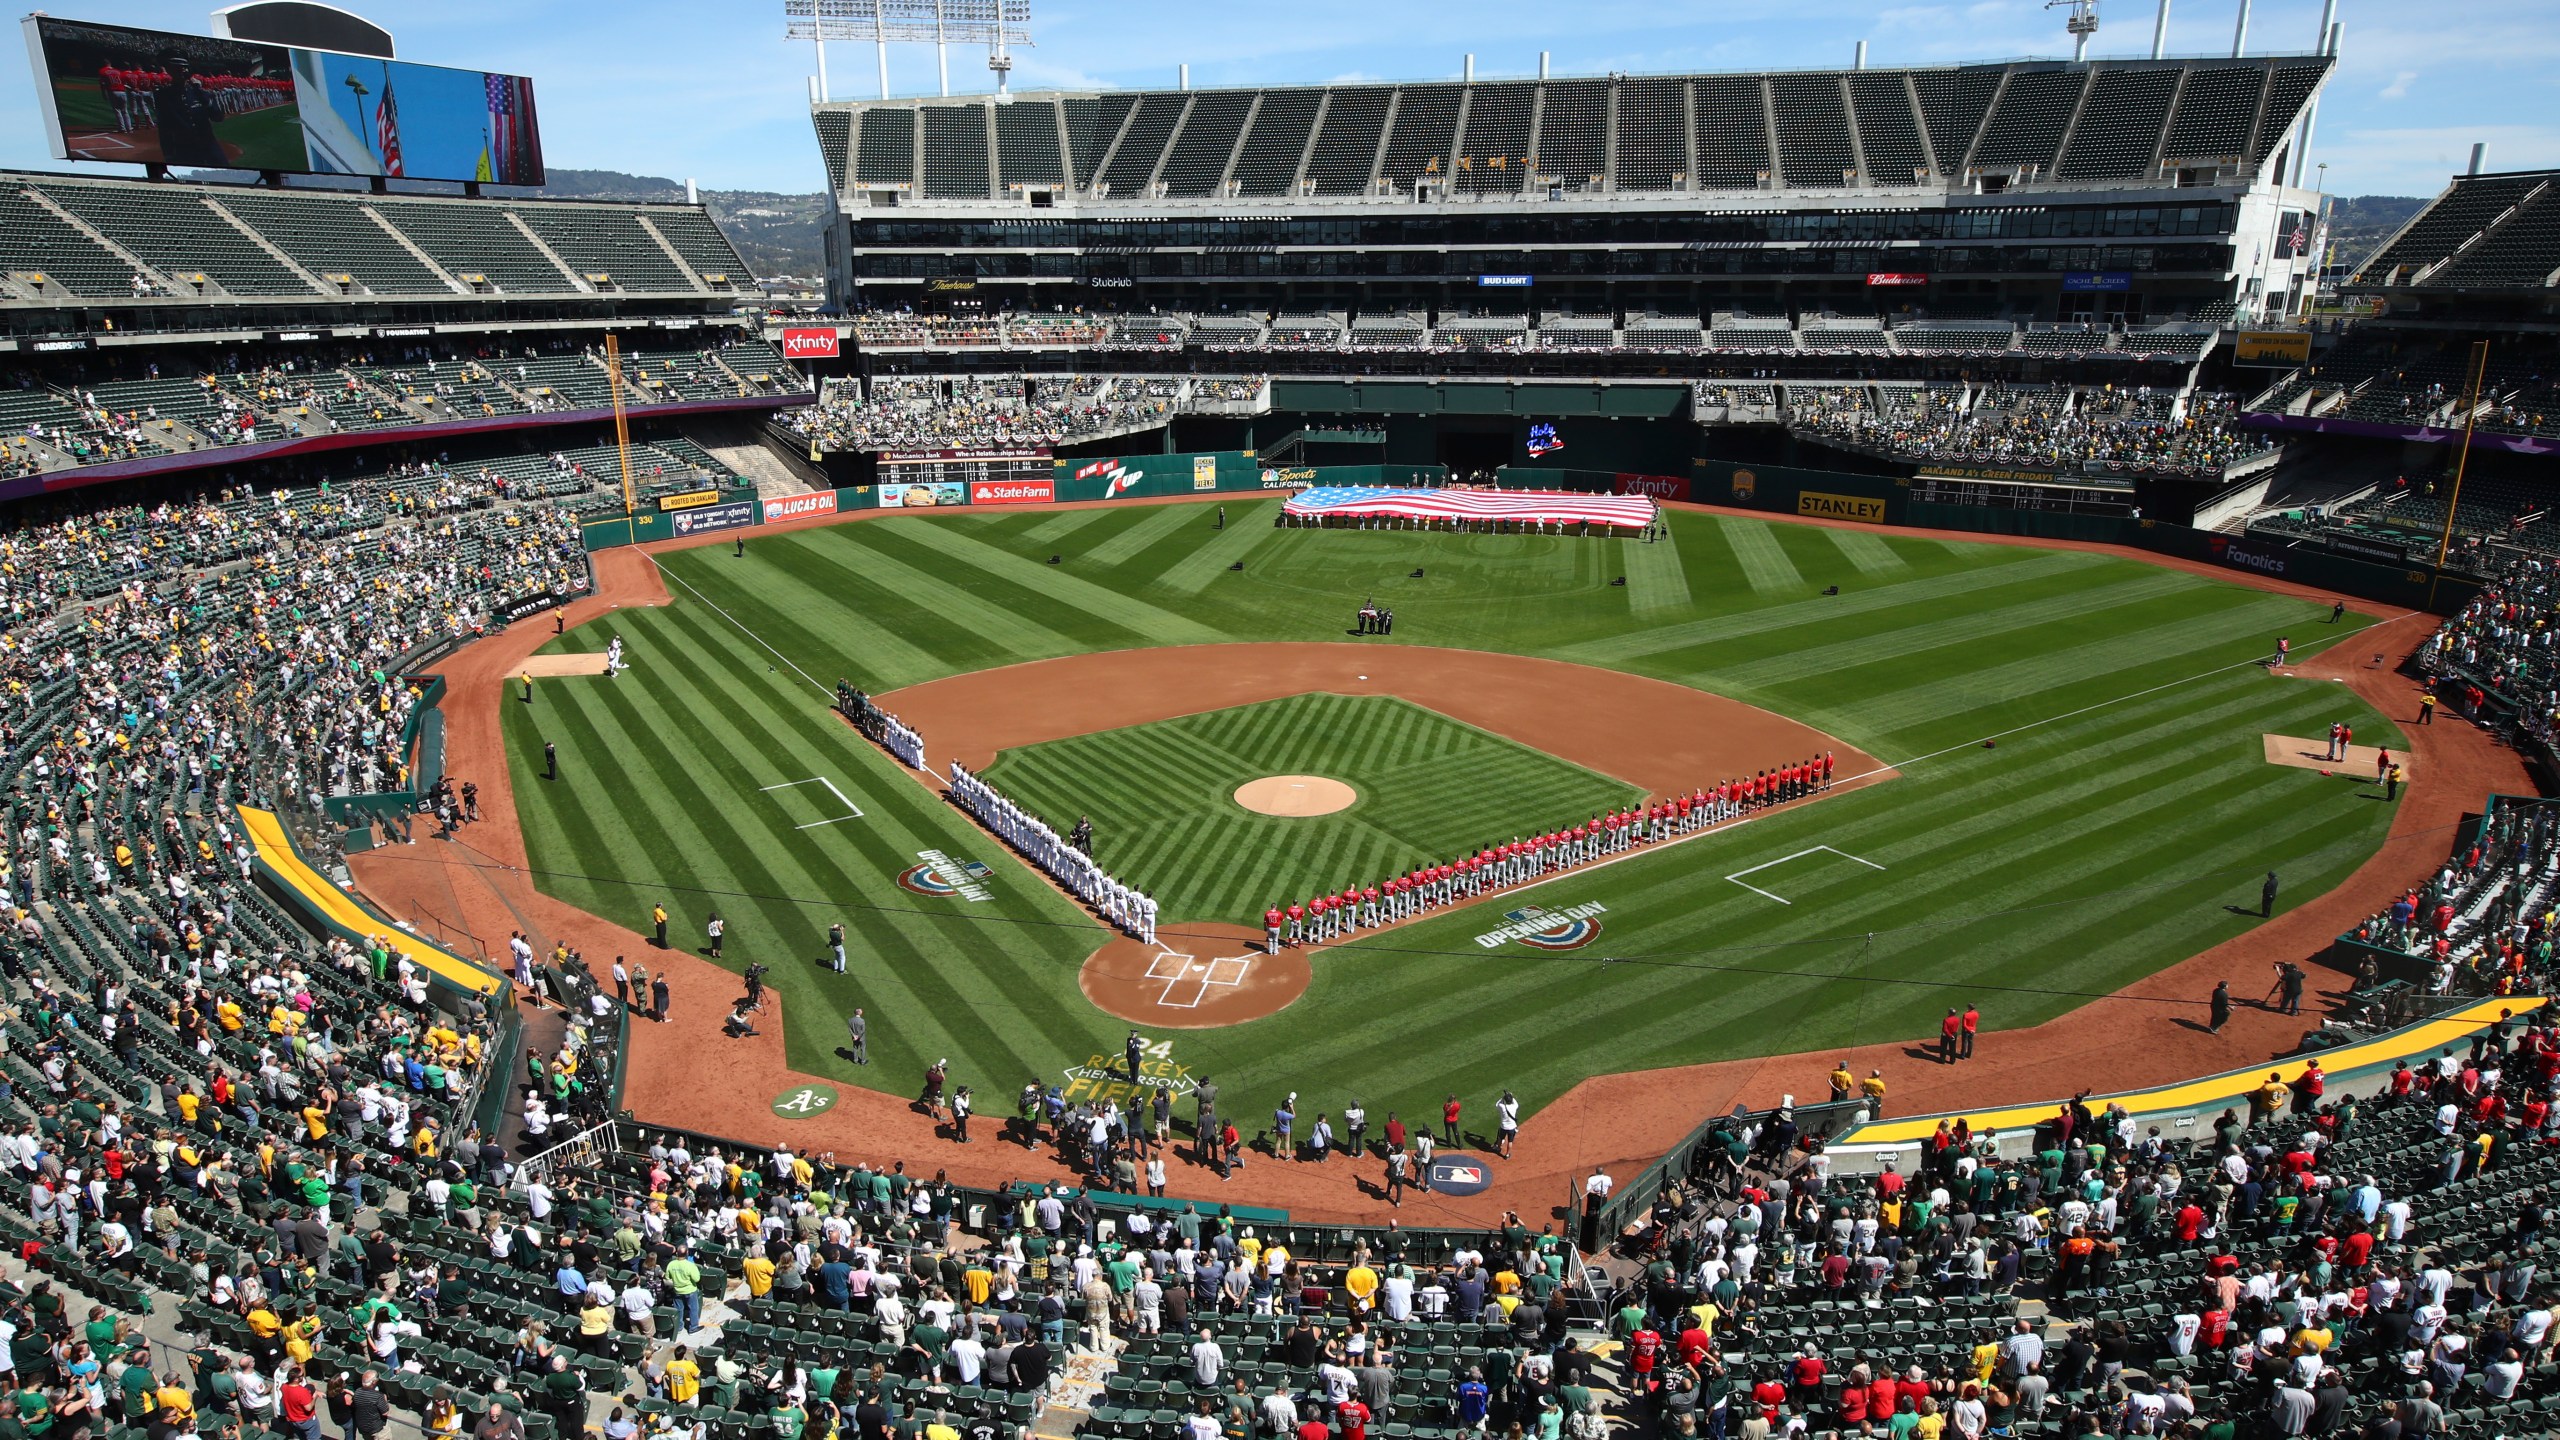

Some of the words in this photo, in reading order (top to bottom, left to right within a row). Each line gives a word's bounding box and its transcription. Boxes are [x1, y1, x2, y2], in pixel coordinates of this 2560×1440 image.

[1092, 277, 1132, 288] StubHub
[1484, 277, 1501, 285] BUD
[1502, 277, 1528, 285] LIGHT
[1869, 274, 1924, 285] Budweiser
[928, 279, 976, 292] Treehouse
[386, 328, 430, 337] FOUNDATION
[33, 340, 87, 352] #RAIDERSPIX
[787, 334, 835, 352] xfinity
[1530, 422, 1556, 438] Holy
[1527, 436, 1565, 454] Toledo
[1054, 459, 1066, 467] 362
[1079, 469, 1085, 478] DO
[1086, 465, 1098, 476] MORE
[1102, 461, 1114, 473] WITH
[1920, 466, 1964, 477] OAKLAND
[1981, 469, 2013, 480] GREEN
[2014, 471, 2054, 482] FRIDAYS
[1278, 468, 1316, 483] Sports
[856, 485, 869, 494] 367
[1196, 480, 1214, 488] FIELD
[1626, 476, 1678, 497] xfinity
[993, 487, 1022, 498] State
[1022, 486, 1050, 498] Farm
[671, 497, 690, 506] ROOTED
[696, 494, 717, 503] OAKLAND
[783, 497, 816, 515] LUCAS
[818, 495, 834, 509] OIL
[727, 507, 751, 518] xfinity
[1801, 497, 1881, 518] STANLEY
[638, 515, 653, 524] 330
[675, 513, 692, 523] MLB
[703, 520, 728, 529] NETWORK
[2227, 544, 2285, 573] Fanatics
[2406, 571, 2427, 584] 330
[916, 849, 976, 889] OPENING
[957, 884, 995, 903] DAY
[1474, 912, 1571, 949] OPENING
[1563, 900, 1612, 920] DAY
[1086, 1054, 1192, 1078] RICKEY
[1077, 1067, 1186, 1089] HENRSON
[775, 1089, 829, 1112] A's
[741, 1177, 753, 1187] 24
[2008, 1180, 2018, 1191] 16
[936, 1188, 944, 1196] 10
[2067, 1213, 2083, 1224] 42
[1863, 1229, 1875, 1238] 24
[2427, 1316, 2443, 1327] 27
[2184, 1326, 2191, 1337] 5
[1639, 1344, 1655, 1356] 27
[672, 1374, 685, 1385] 52
[1327, 1371, 1347, 1382] CROSBY
[1333, 1380, 1343, 1391] 7
[2141, 1406, 2159, 1417] 42
[1344, 1416, 1361, 1429] 27
